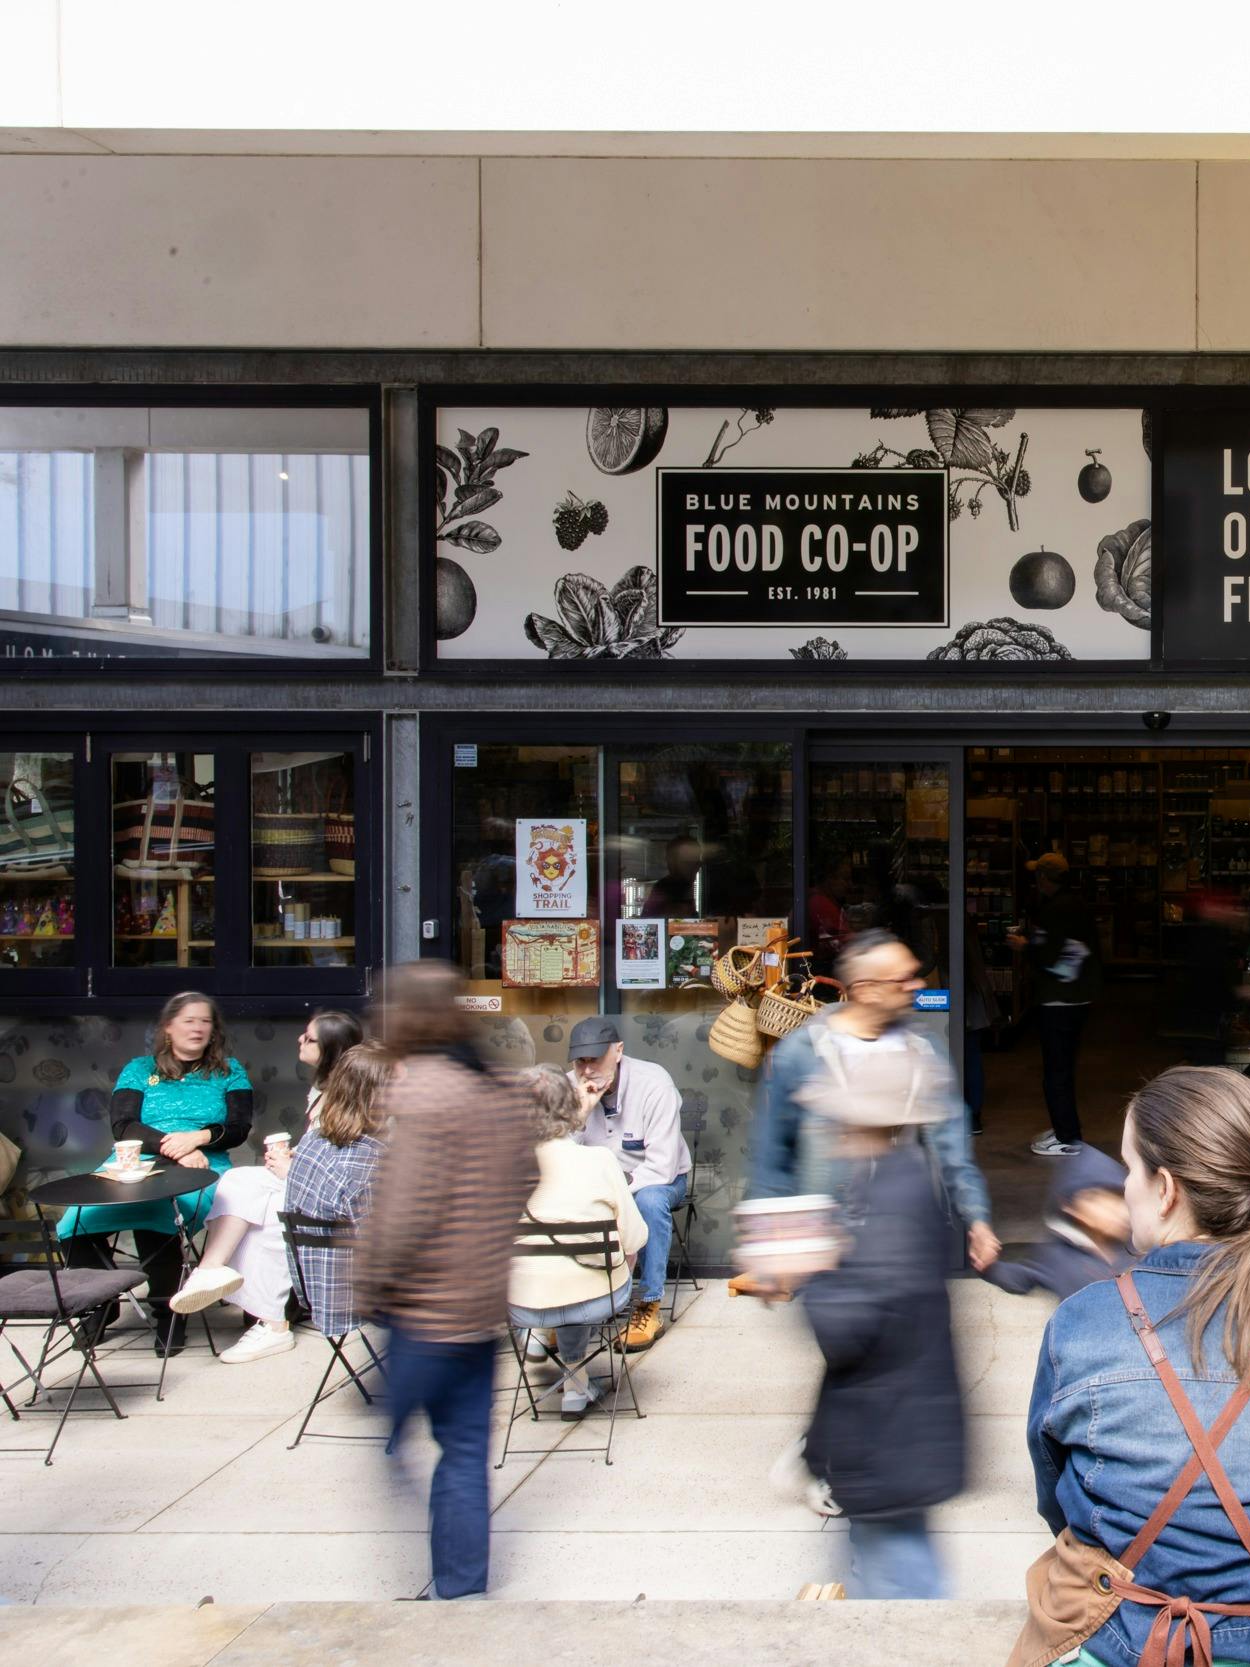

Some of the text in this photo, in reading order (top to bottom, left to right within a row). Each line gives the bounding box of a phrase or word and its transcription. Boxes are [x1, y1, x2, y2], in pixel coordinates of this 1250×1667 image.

[685, 494, 920, 511] BLUE MOUNTAINS
[685, 523, 920, 573] FOOD CO-OP
[768, 587, 837, 600] EST. 1981
[533, 892, 572, 900] SHOPPING
[533, 900, 572, 908] TRAIL
